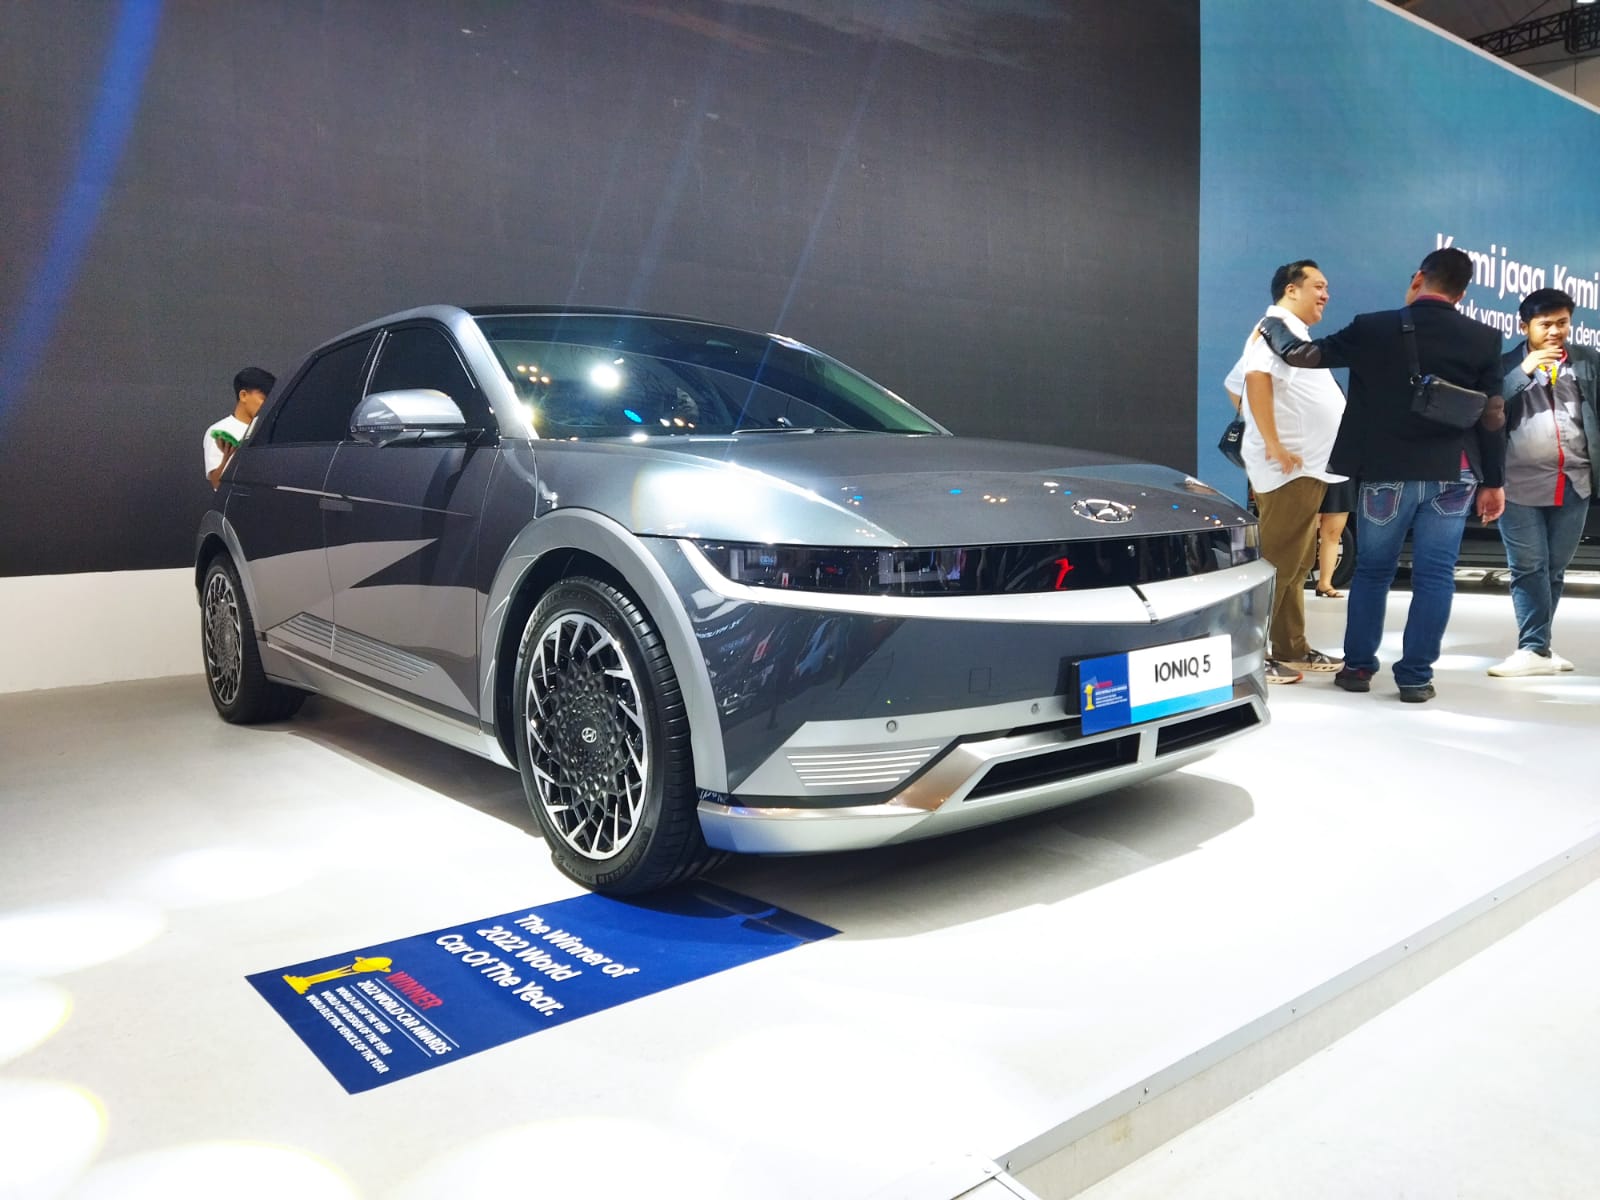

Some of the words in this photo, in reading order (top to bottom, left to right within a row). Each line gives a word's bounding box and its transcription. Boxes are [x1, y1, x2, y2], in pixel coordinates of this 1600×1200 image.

[1553, 263, 1599, 311] Kami
[1154, 656, 1200, 683] IONIQ
[1202, 654, 1212, 674] 5
[435, 933, 474, 955] Car
[461, 950, 500, 968] Of
[476, 925, 530, 953] 2022
[514, 946, 583, 982] World
[513, 913, 551, 935] The
[542, 929, 613, 967] Winner
[601, 962, 641, 978] of
[385, 970, 444, 1011] WINNER
[480, 961, 522, 987] The
[356, 979, 382, 996] 2022
[370, 990, 406, 1016] WORLD
[396, 1011, 421, 1029] CAR
[409, 1023, 453, 1055] AWARDS
[511, 980, 565, 1017] Year.
